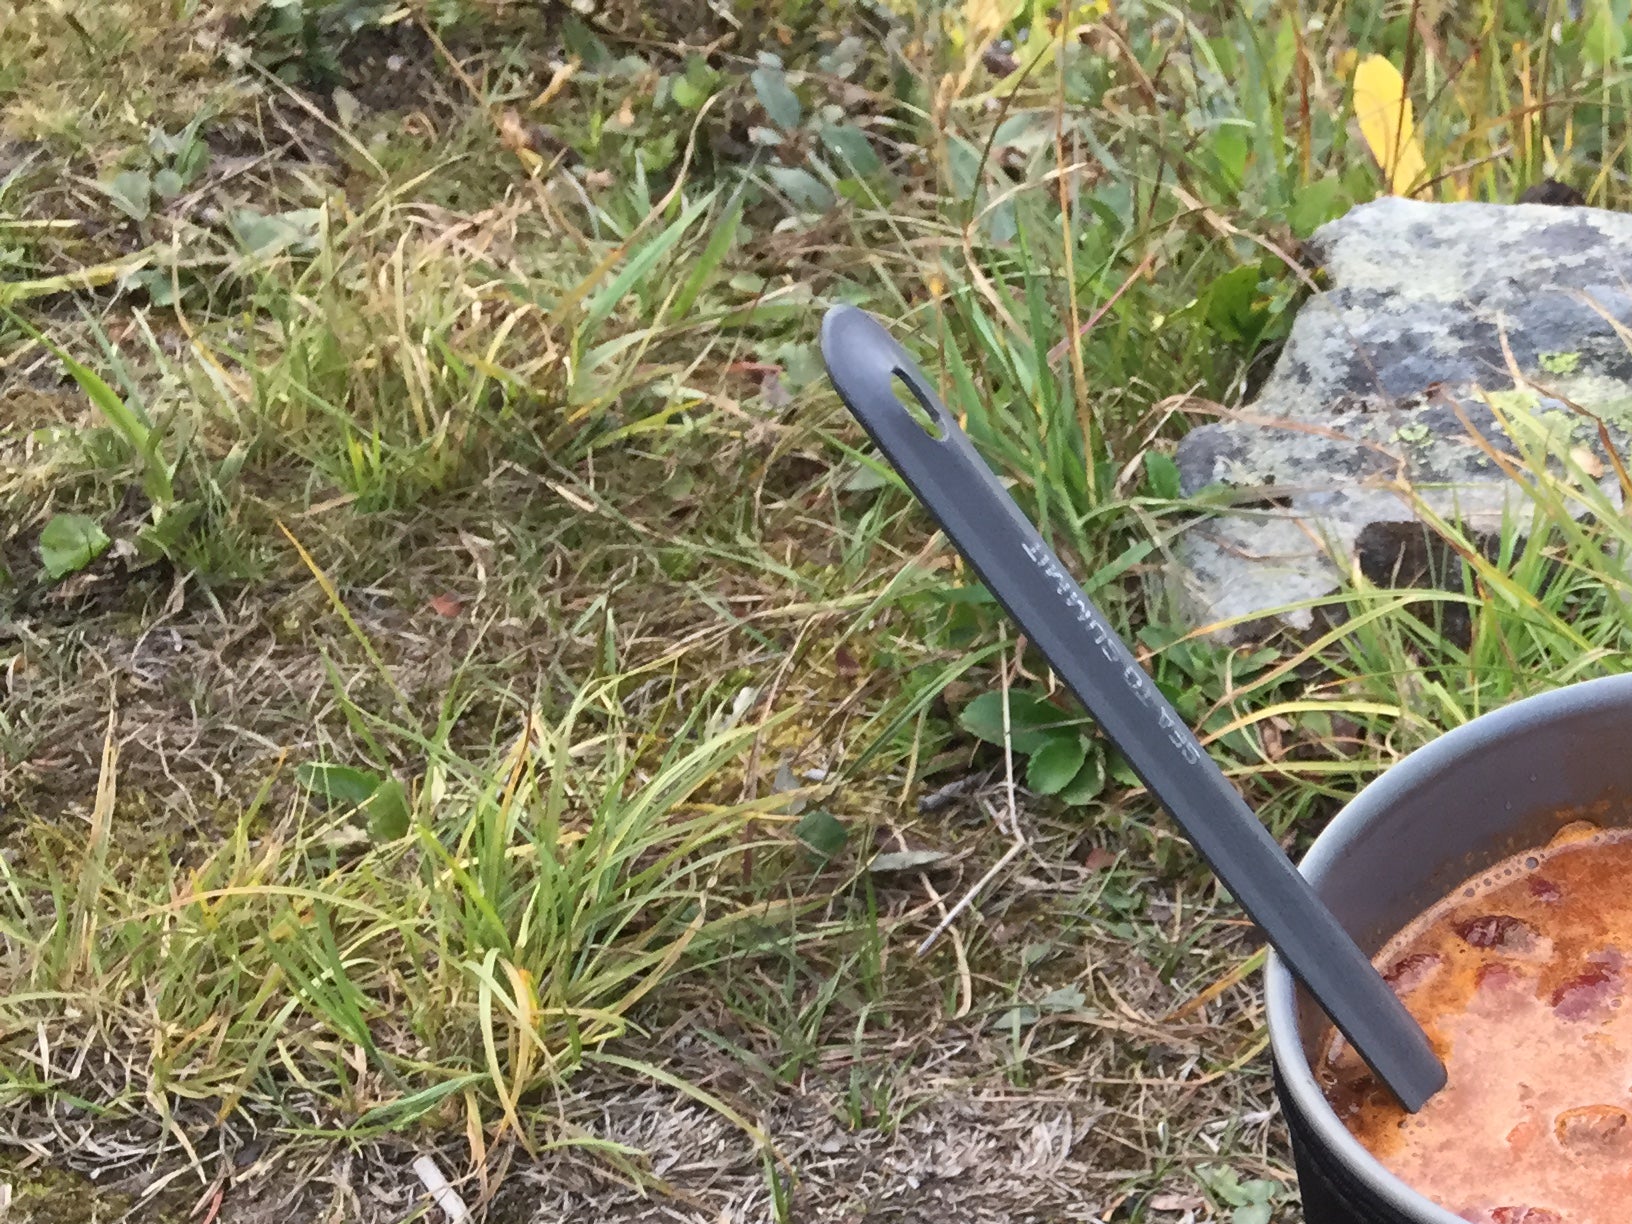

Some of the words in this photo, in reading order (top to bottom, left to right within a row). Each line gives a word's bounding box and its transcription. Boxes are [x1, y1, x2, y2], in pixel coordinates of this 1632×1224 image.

[1021, 542, 1121, 662] SUMMIT
[1124, 665, 1151, 708] TO
[1158, 706, 1201, 765] SEA
